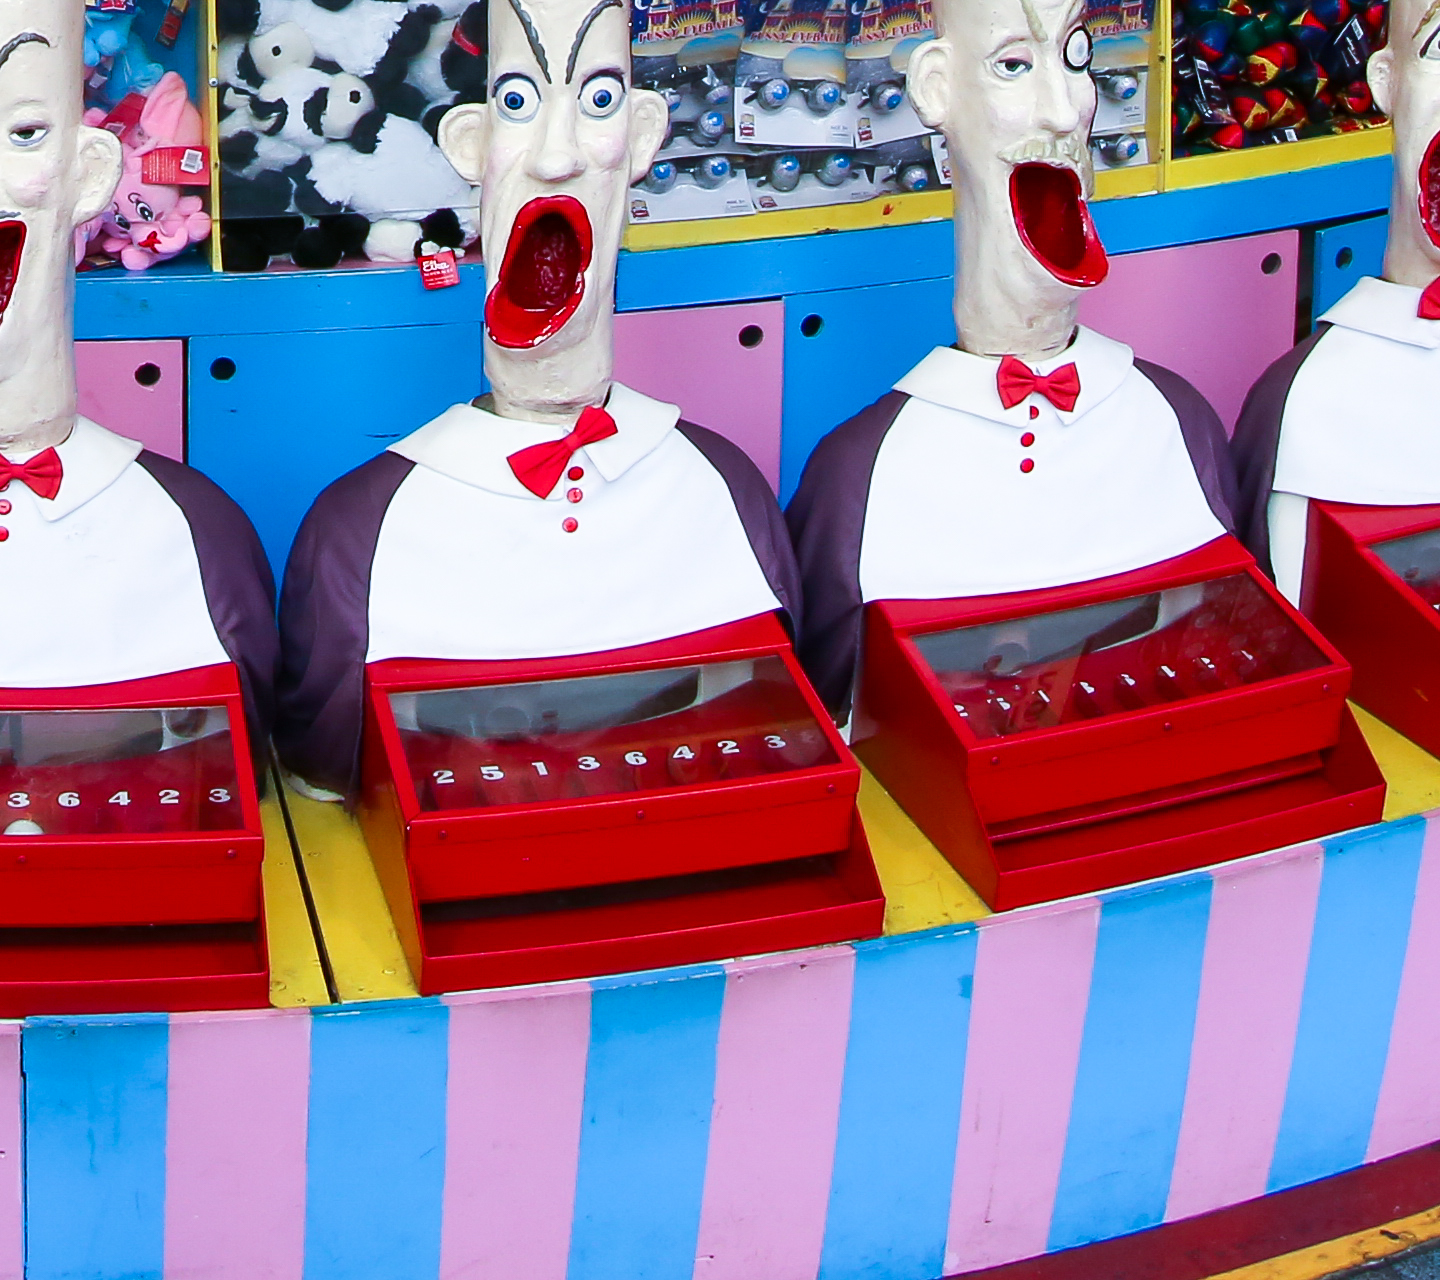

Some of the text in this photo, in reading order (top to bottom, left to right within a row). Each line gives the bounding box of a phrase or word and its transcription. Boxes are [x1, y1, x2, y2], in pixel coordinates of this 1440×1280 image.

[7, 791, 30, 807] 3
[58, 791, 80, 807] 6
[108, 790, 131, 806] 4
[158, 789, 180, 805] 2
[208, 788, 231, 803] 3
